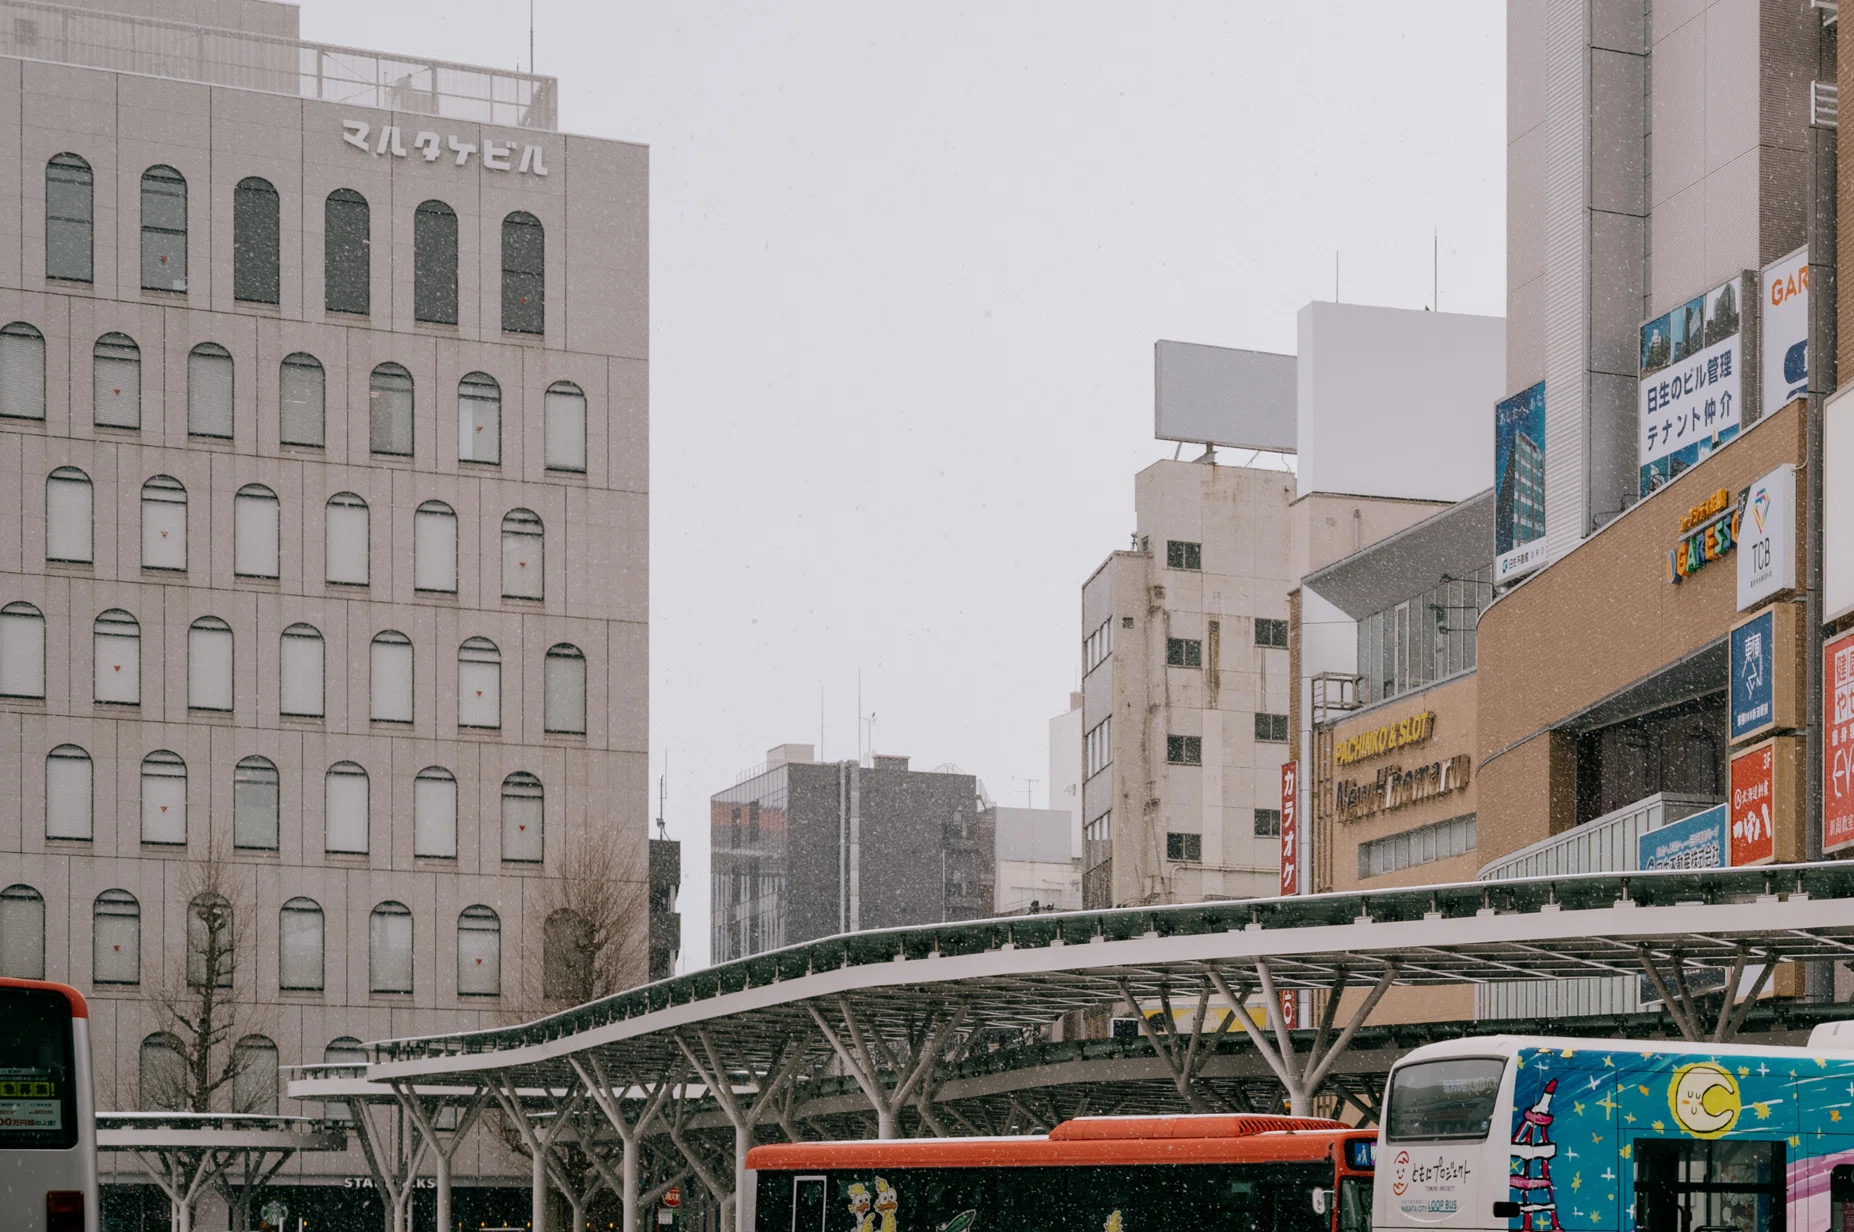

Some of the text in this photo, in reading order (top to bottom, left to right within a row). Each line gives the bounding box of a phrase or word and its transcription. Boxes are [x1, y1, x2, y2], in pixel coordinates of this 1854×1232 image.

[342, 119, 548, 176] マルタケビル
[1647, 349, 1732, 415] 日生のビル管理
[1647, 390, 1733, 453] テナント仲介
[1752, 537, 1771, 574] TCB
[1334, 712, 1428, 765] PACHINKO & SLOT
[1763, 752, 1771, 769] 3F
[1337, 780, 1373, 822] New
[1283, 770, 1295, 888] カラオケ
[1733, 804, 1771, 844] つぼ八
[344, 1177, 436, 1189] STAKS
[1428, 1200, 1443, 1211] LOOP
[1445, 1200, 1457, 1210] BUS
